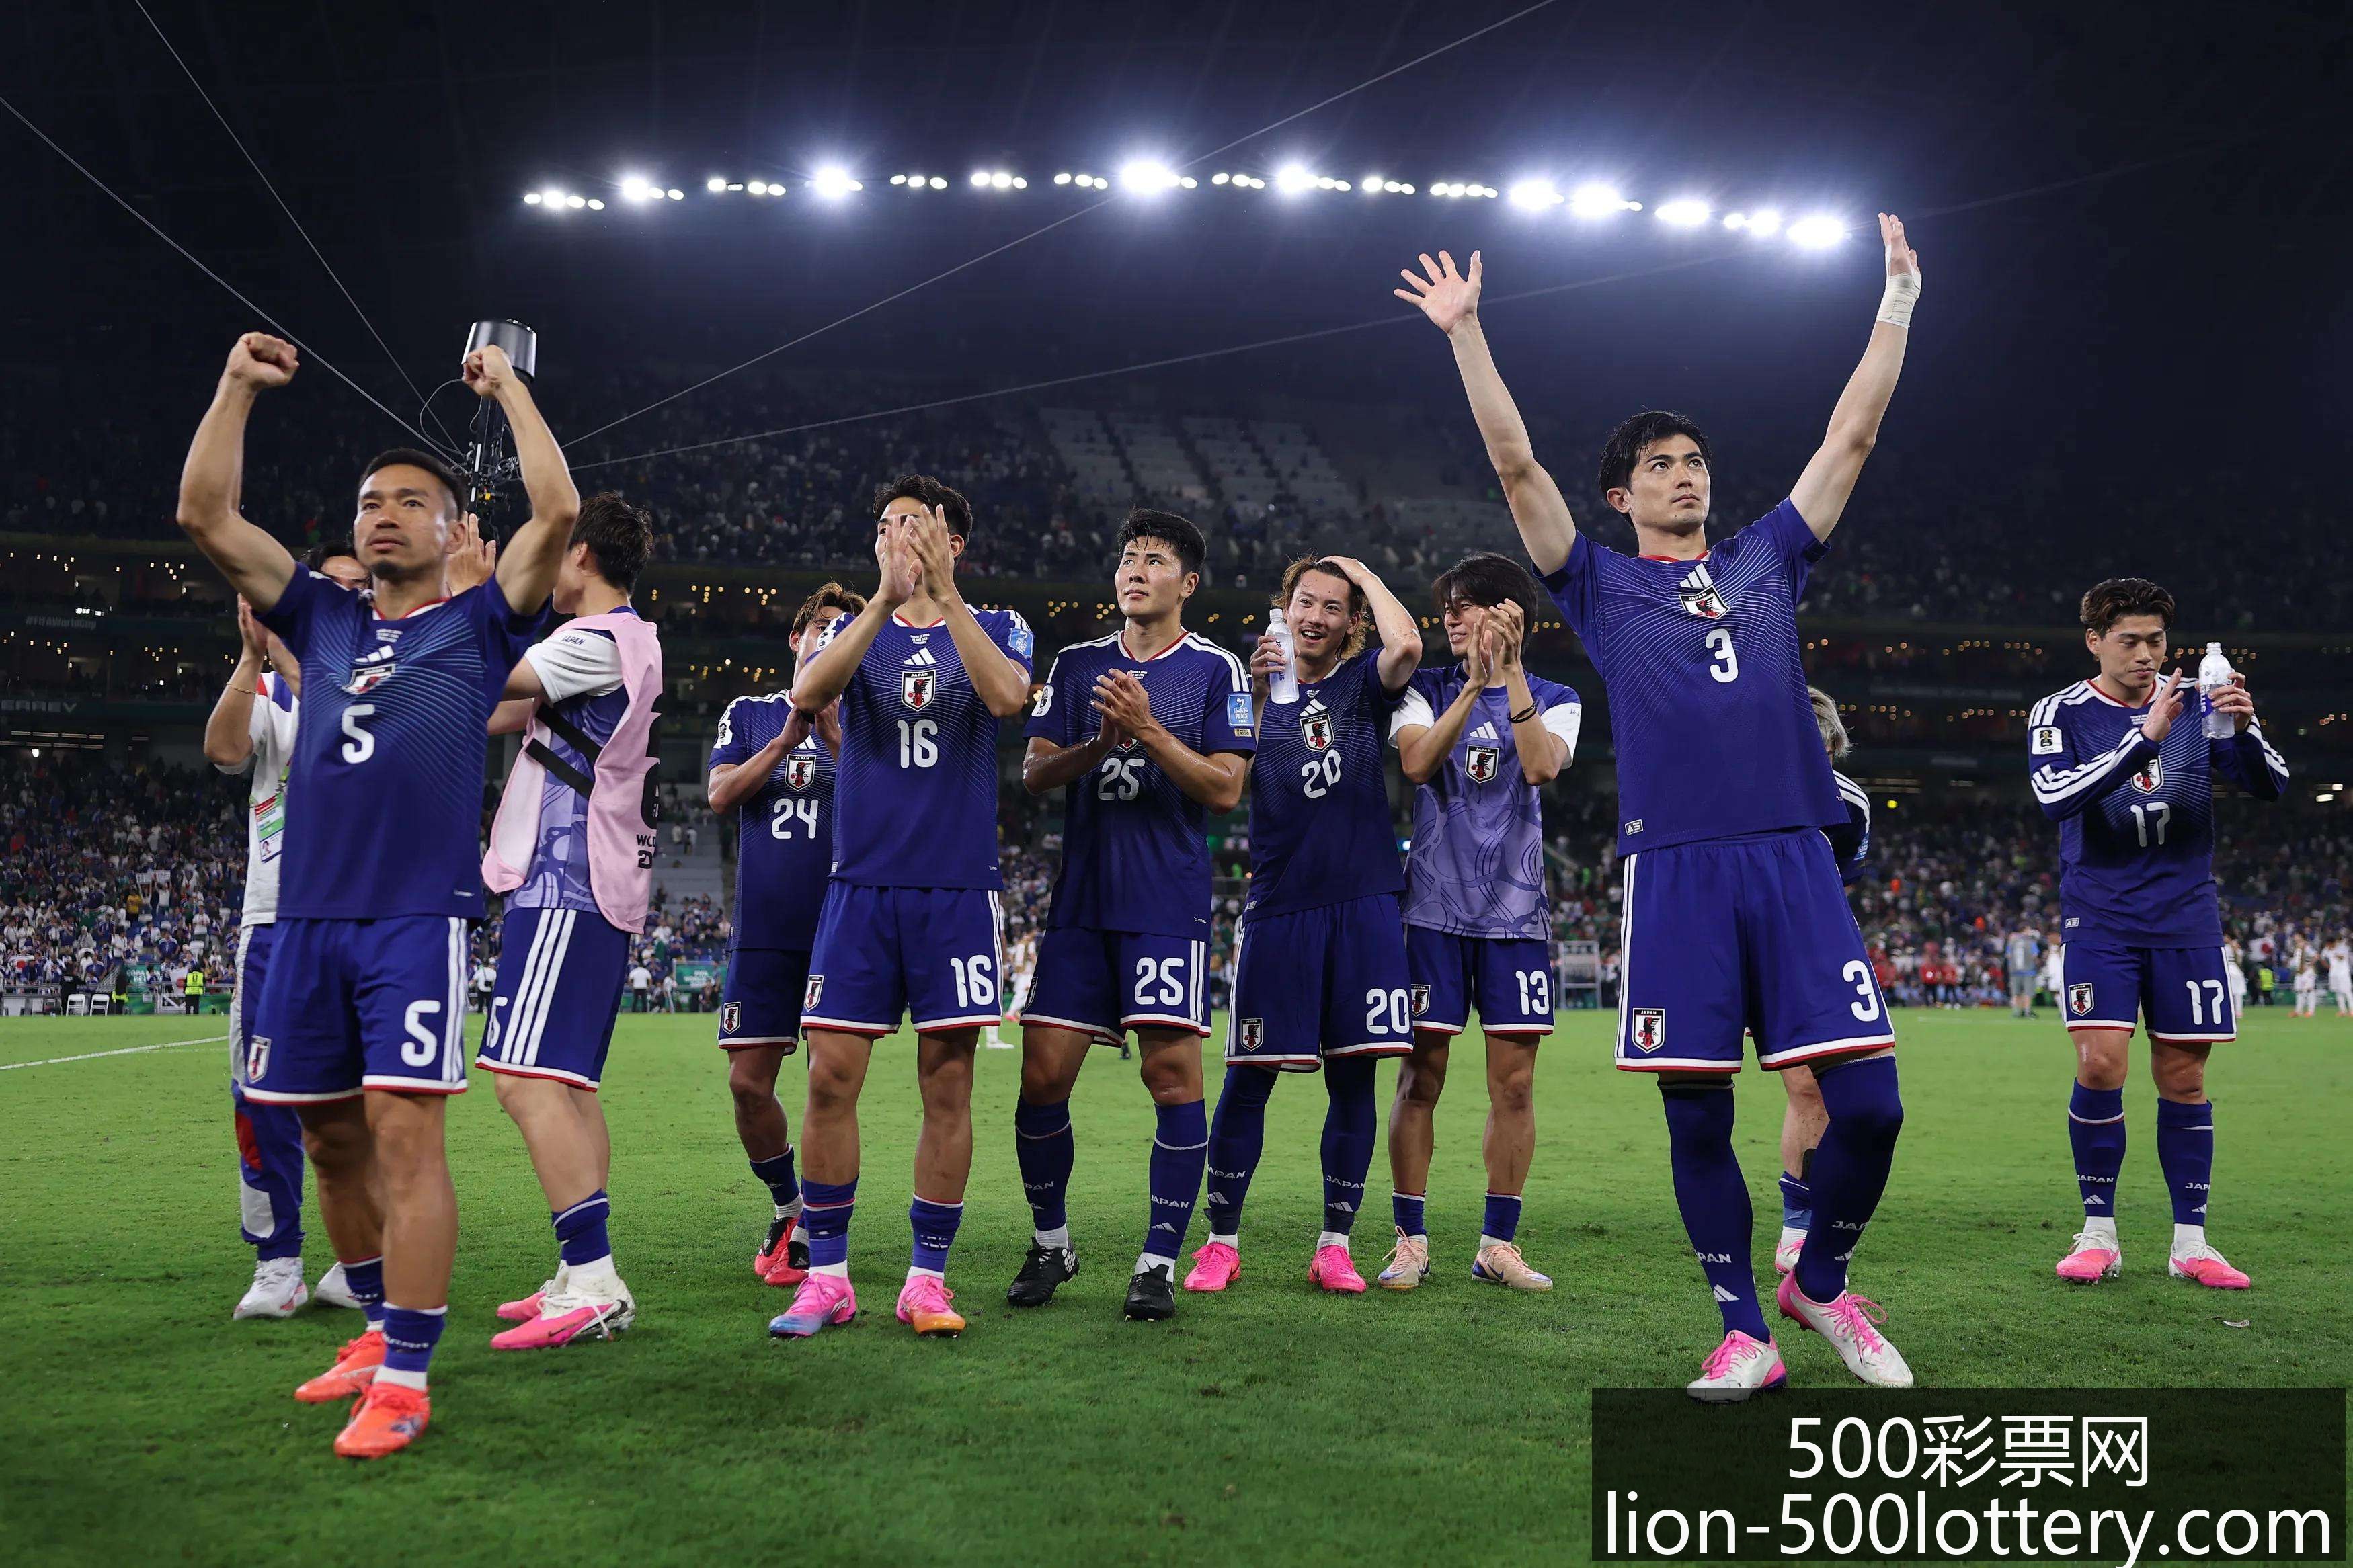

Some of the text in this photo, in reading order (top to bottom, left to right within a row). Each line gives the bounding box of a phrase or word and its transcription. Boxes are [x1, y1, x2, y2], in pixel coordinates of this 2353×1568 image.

[1688, 592, 1707, 601] JAPAN
[560, 636, 586, 646] JAPAN
[1706, 628, 1739, 683] 3
[342, 704, 376, 764] 5
[897, 719, 939, 768] 16
[1097, 757, 1146, 801] 25
[1301, 749, 1342, 799] 20
[772, 798, 819, 839] 24
[2130, 802, 2171, 848] 17
[950, 954, 994, 1008] 16
[1135, 957, 1185, 1006] 25
[1515, 970, 1550, 1016] 13
[1842, 960, 1880, 1022] 3
[2186, 979, 2225, 1025] 17
[401, 1000, 440, 1067] 5
[1366, 988, 1410, 1034] 20
[1025, 1180, 1054, 1190] PAN
[2185, 1182, 2210, 1190] JAP
[1695, 1250, 1732, 1264] PAN
